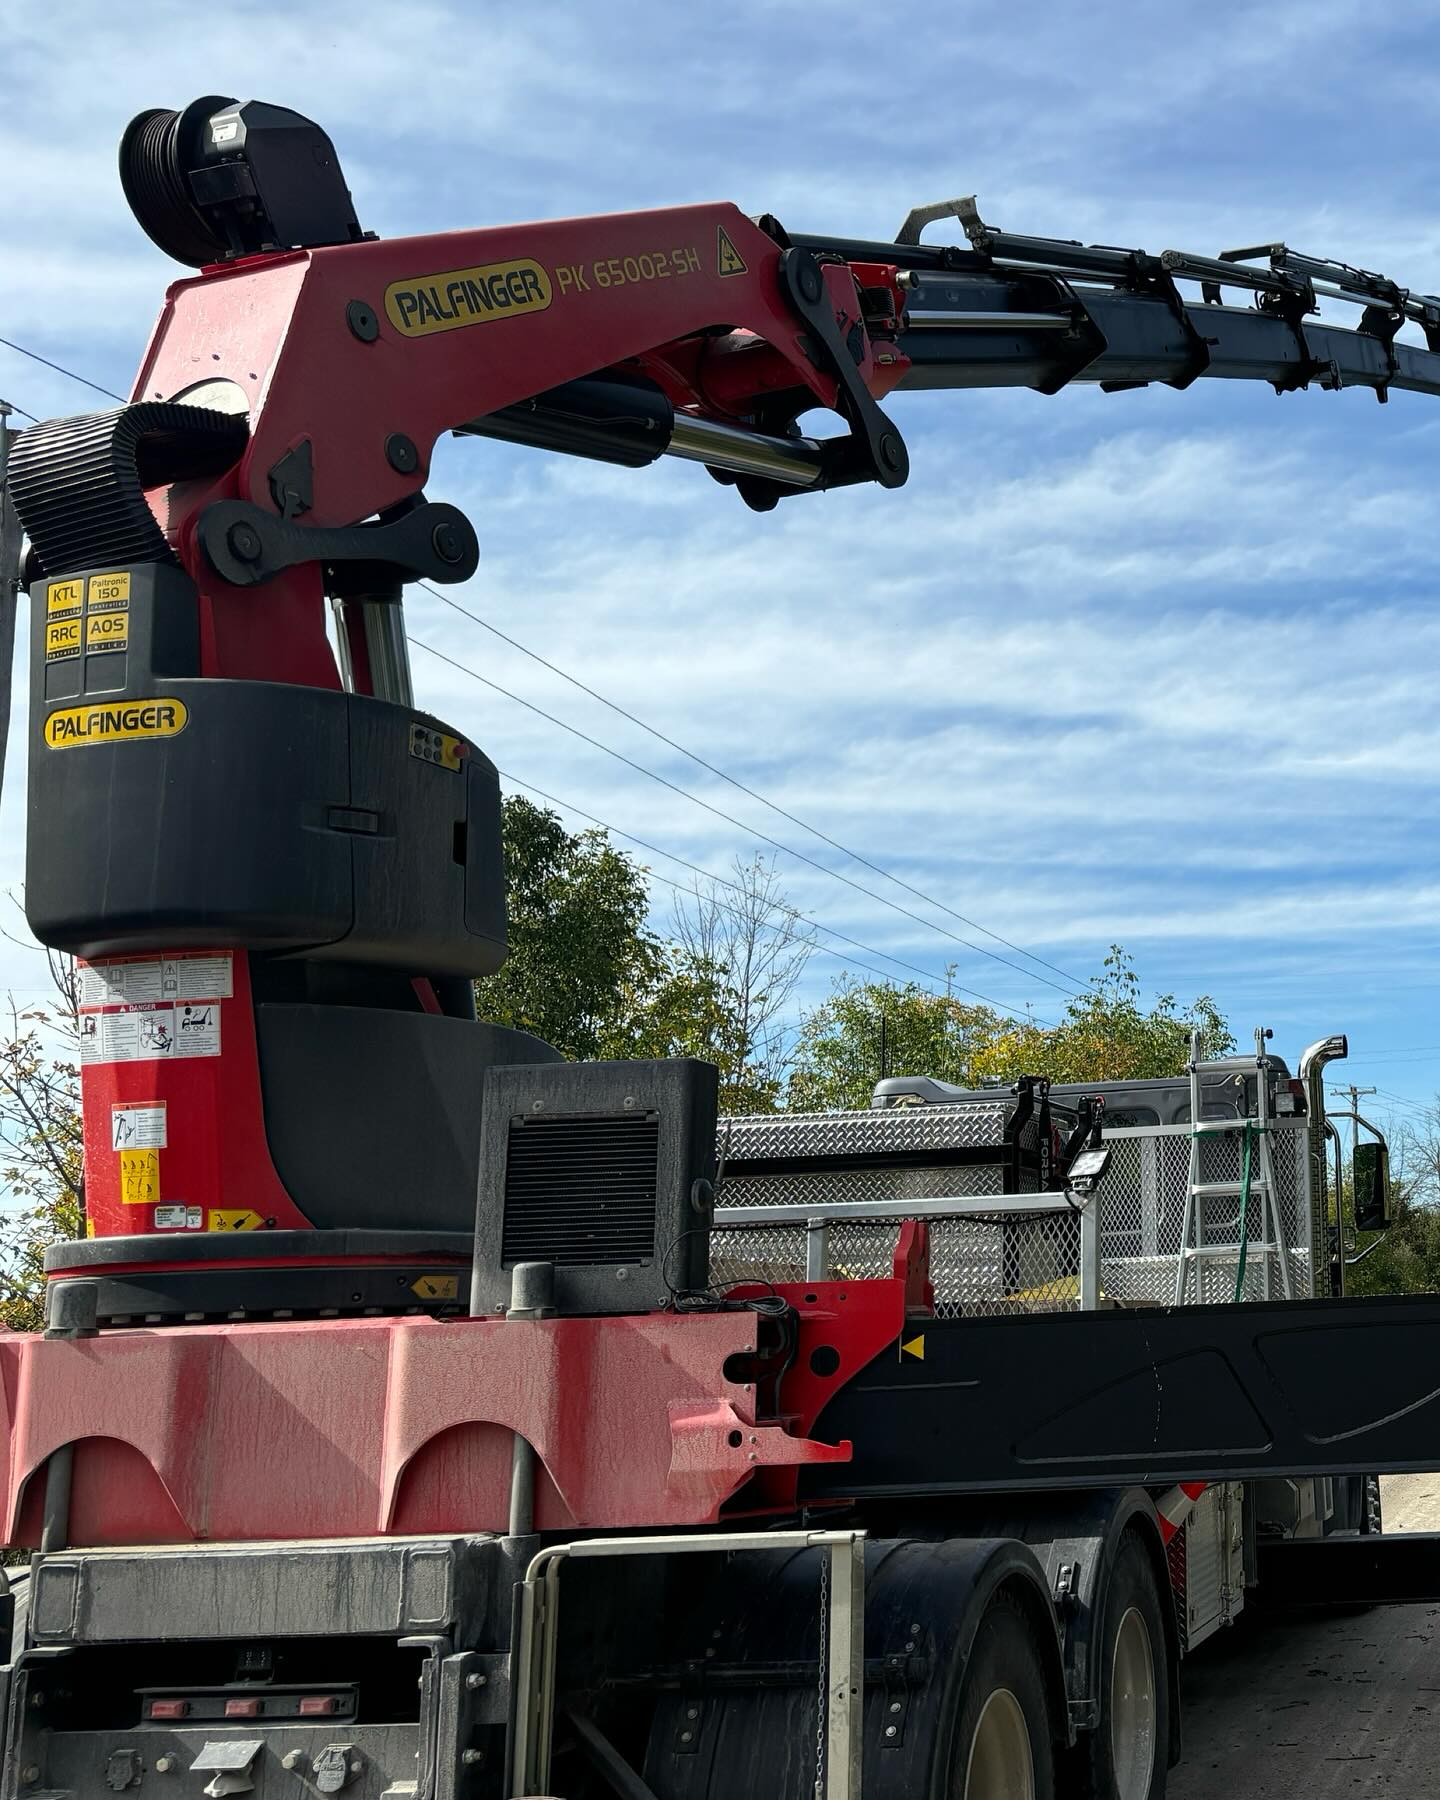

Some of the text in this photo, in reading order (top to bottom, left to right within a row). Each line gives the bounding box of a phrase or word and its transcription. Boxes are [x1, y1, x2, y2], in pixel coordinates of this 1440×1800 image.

[393, 268, 545, 329] PALFINGER
[555, 264, 591, 295] PK
[91, 577, 128, 588] Paltronic
[53, 586, 78, 602] KTL
[98, 587, 119, 599] 150
[50, 625, 78, 643] RRC
[90, 618, 124, 634] AOS
[52, 706, 176, 741] PALFINGER
[128, 1002, 157, 1012] DANGER
